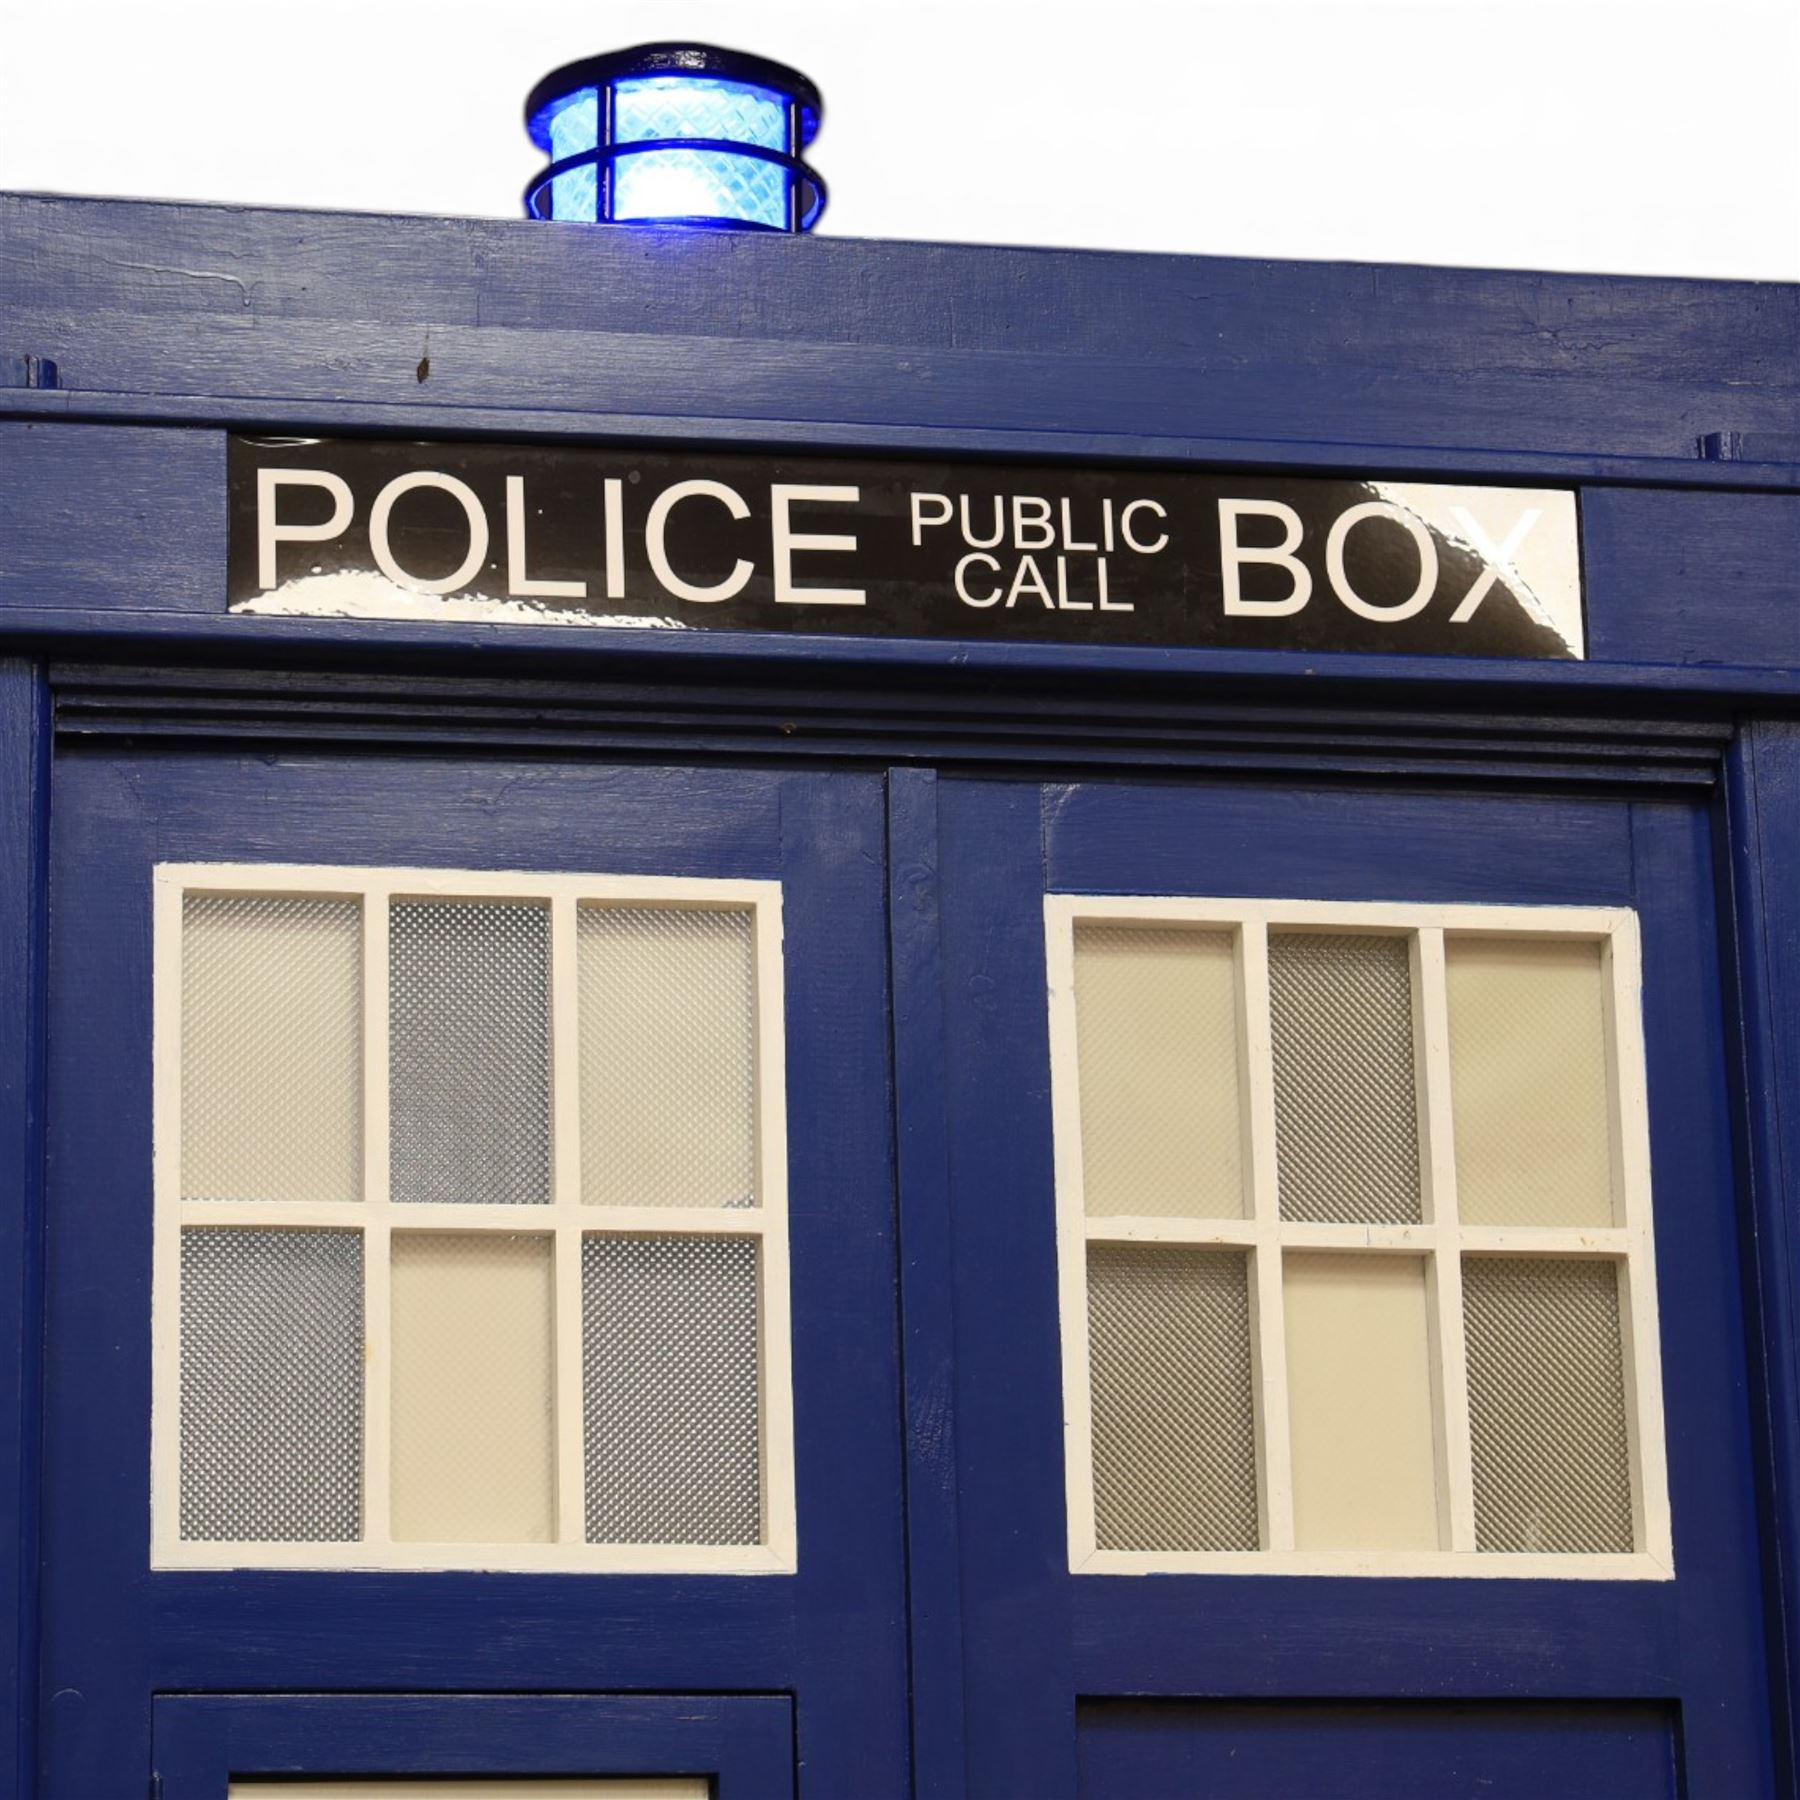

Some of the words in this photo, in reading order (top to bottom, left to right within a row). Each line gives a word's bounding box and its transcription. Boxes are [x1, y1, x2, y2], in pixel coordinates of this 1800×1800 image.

[257, 468, 866, 605] POLICE
[910, 492, 1169, 554] PUBLIC
[1218, 498, 1549, 624] BOX
[954, 551, 1135, 612] CALL
